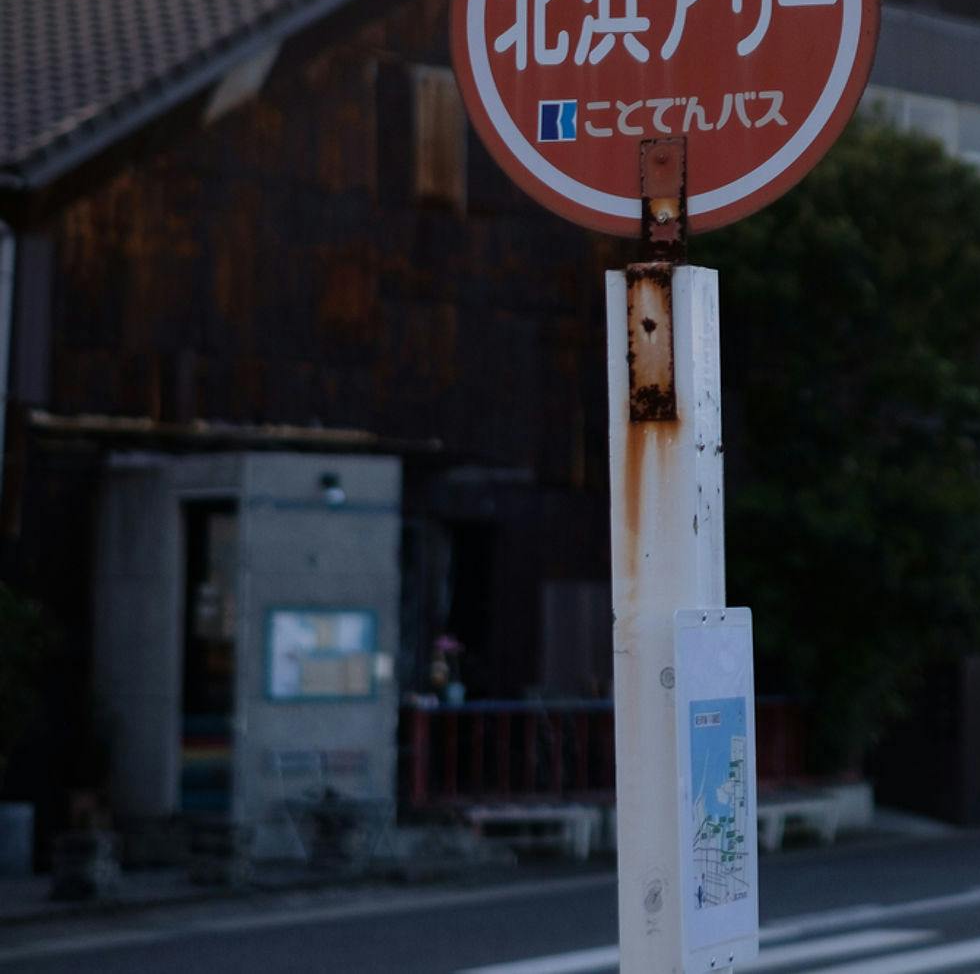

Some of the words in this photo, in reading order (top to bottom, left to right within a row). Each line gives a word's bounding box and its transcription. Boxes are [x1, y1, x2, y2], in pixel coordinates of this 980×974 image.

[585, 91, 788, 137] ことでんバス
